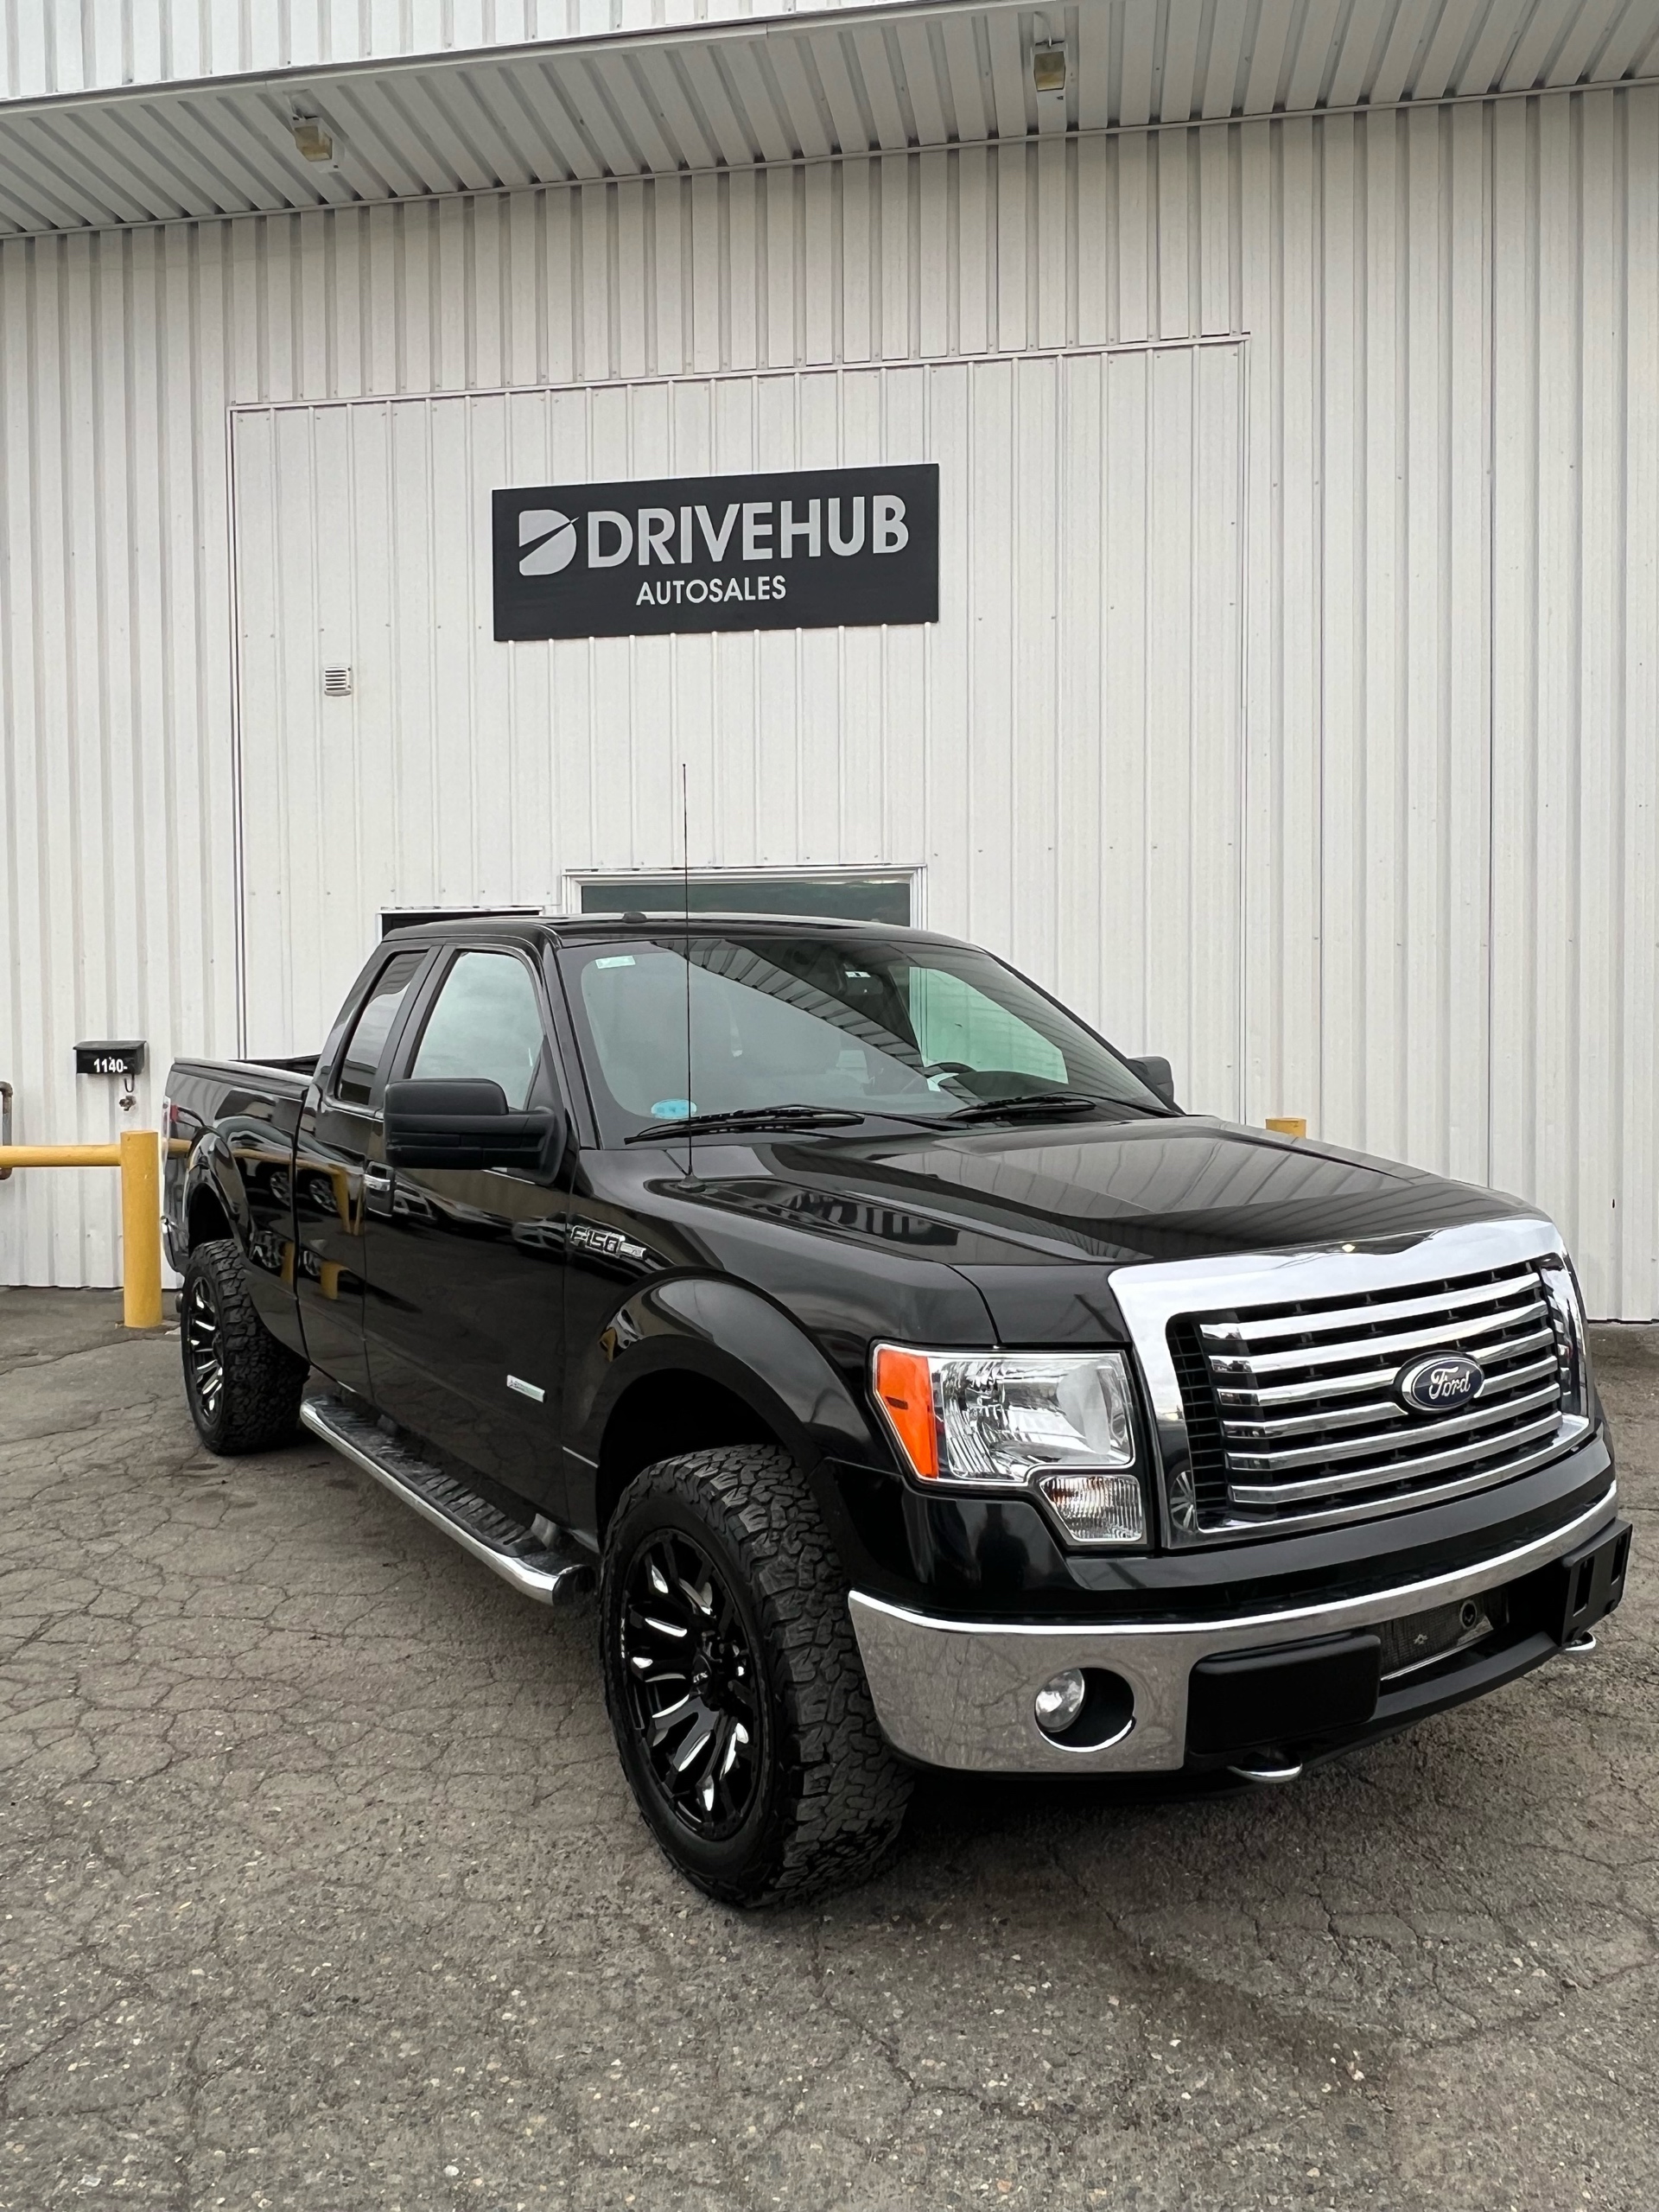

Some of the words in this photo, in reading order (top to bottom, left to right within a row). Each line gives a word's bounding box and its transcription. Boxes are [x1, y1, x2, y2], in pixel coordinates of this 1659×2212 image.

[587, 494, 910, 569] DRIVEHUB
[635, 575, 787, 606] AUTOSALES
[1428, 1366, 1471, 1400] Ford
